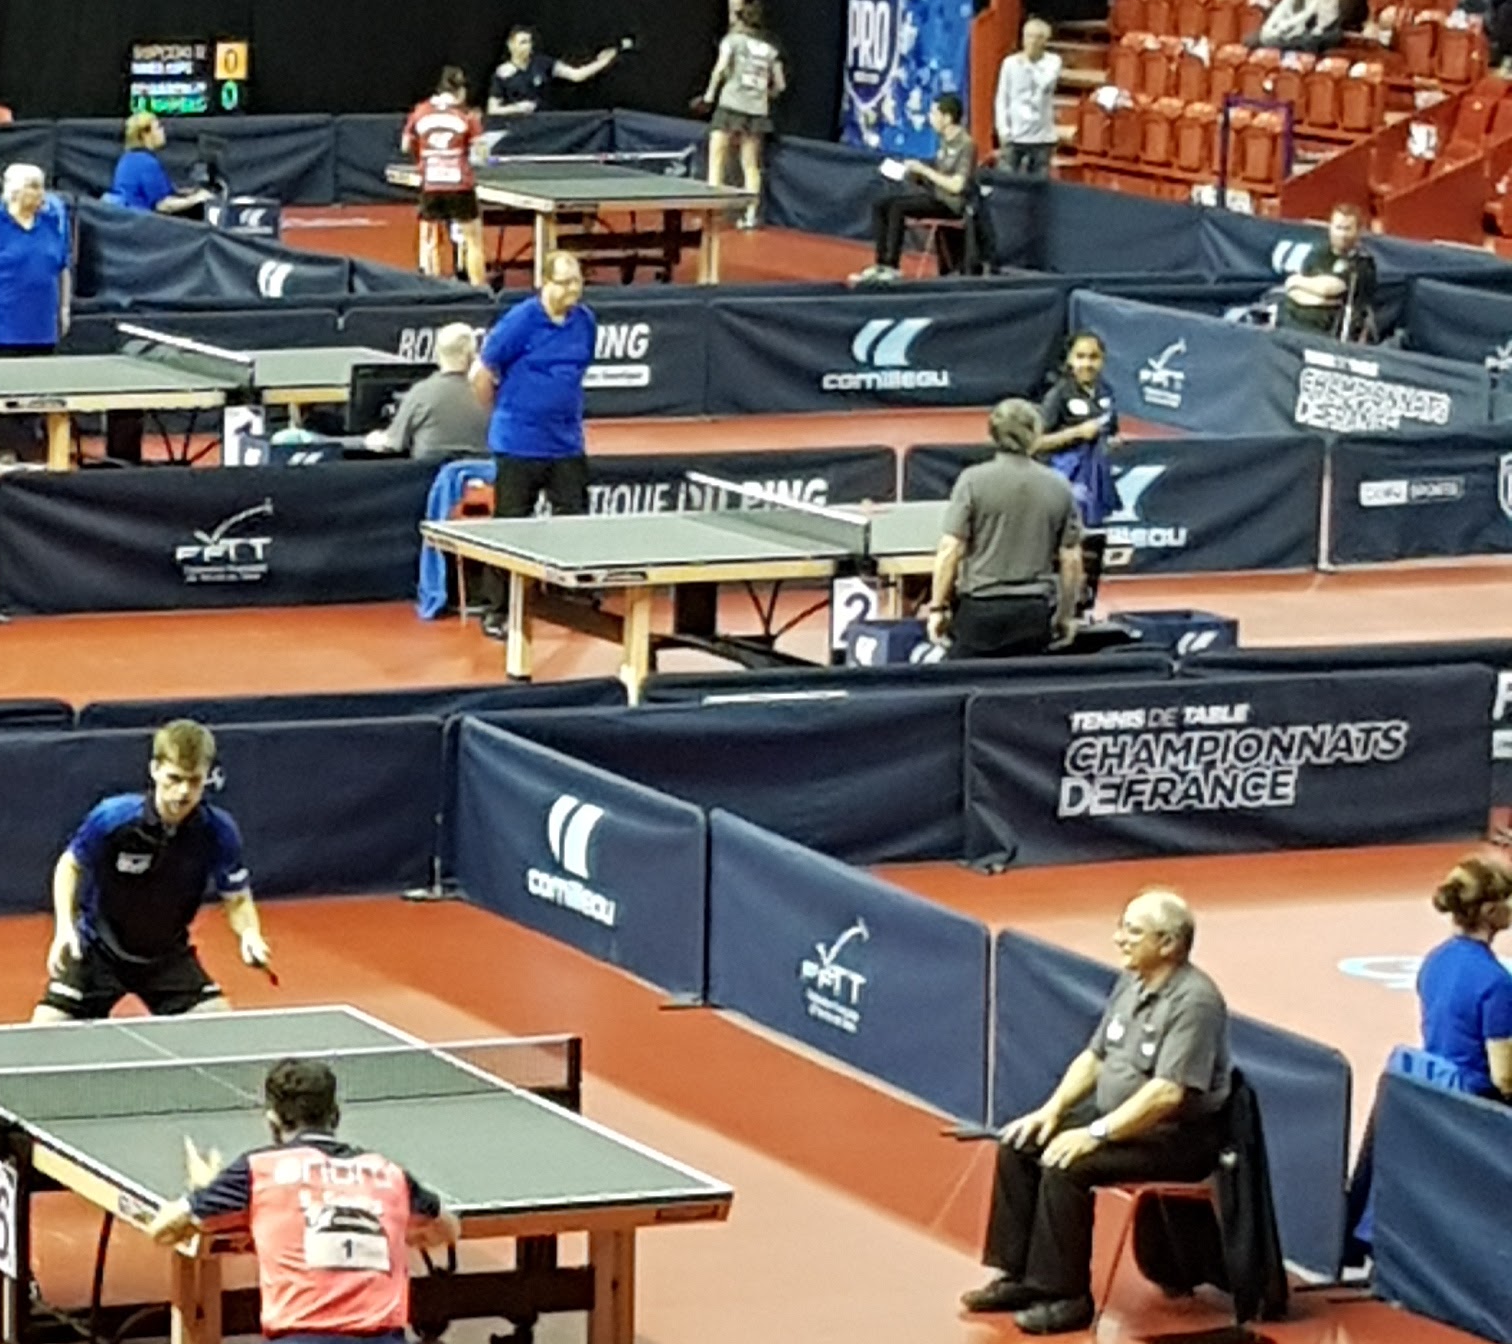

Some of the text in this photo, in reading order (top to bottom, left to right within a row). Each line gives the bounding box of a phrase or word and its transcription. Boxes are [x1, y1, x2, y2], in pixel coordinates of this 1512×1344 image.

[225, 49, 238, 74] 0
[221, 80, 239, 110] 0
[594, 324, 652, 359] ING
[587, 483, 670, 515] TIQUE
[840, 591, 872, 642] 2
[1070, 704, 1251, 732] TENNIS DE TABLE
[1064, 720, 1411, 778] CHAMPIONNATS
[1057, 765, 1300, 817] DE FRANCE
